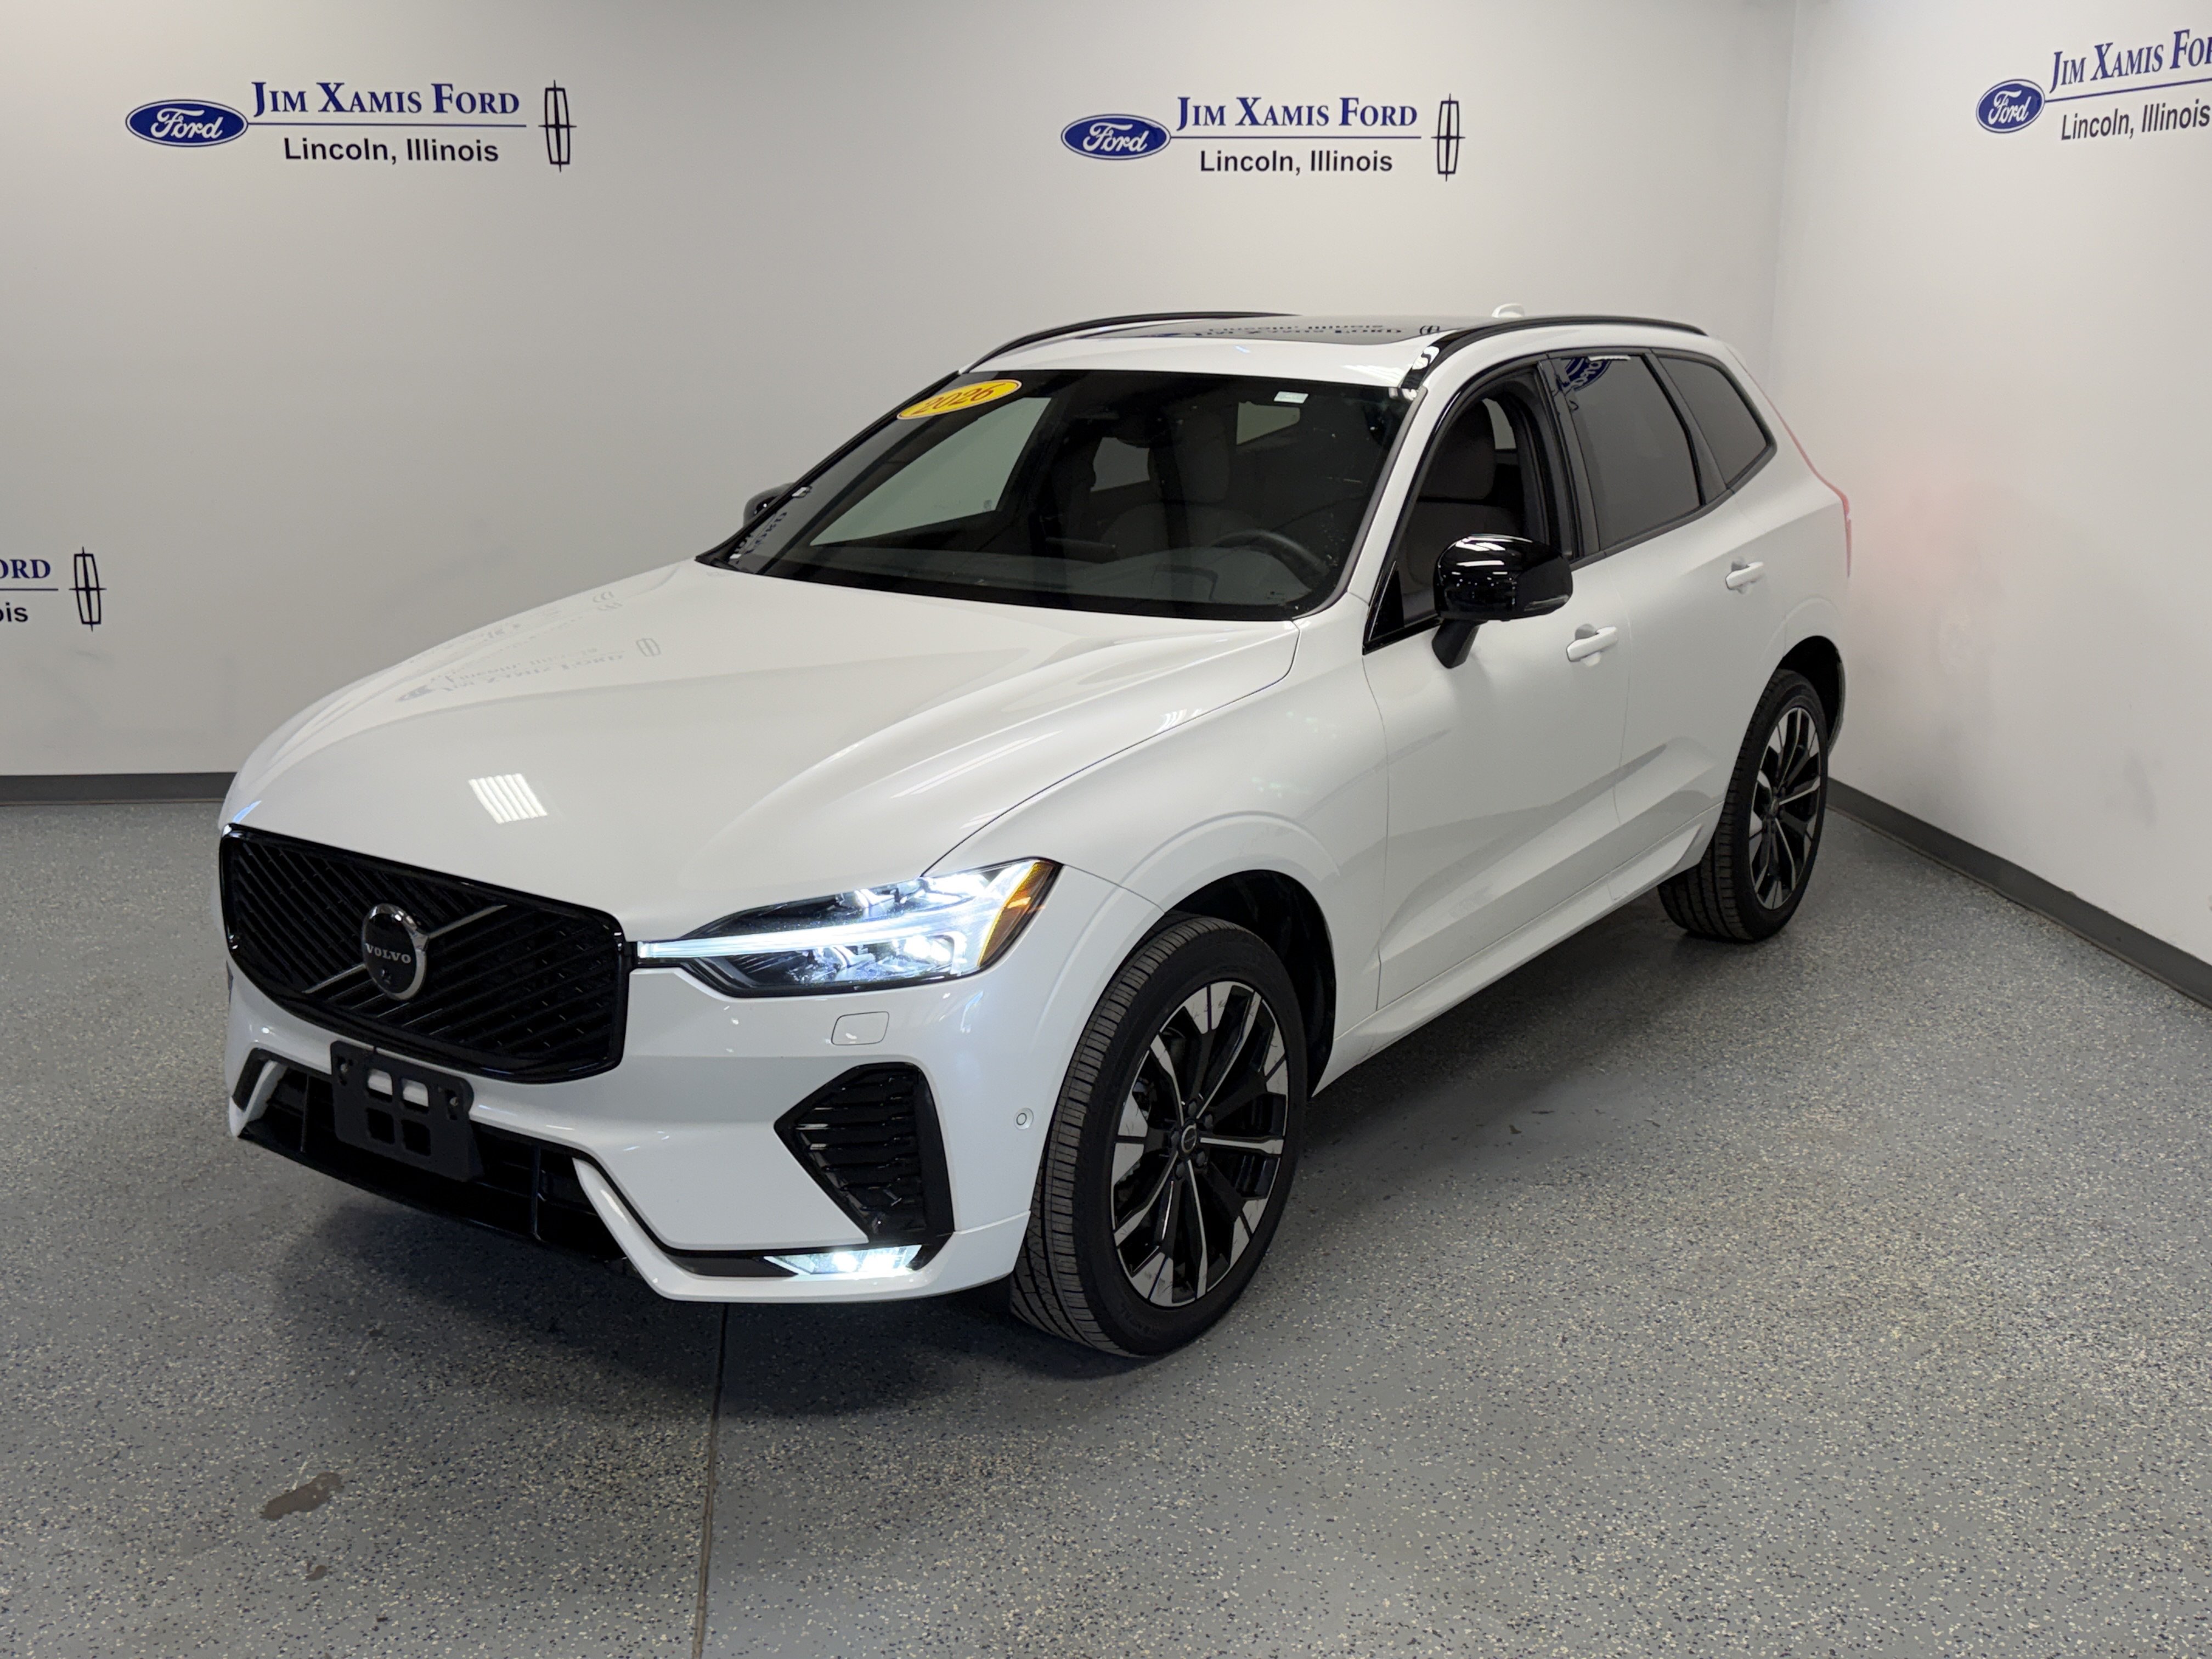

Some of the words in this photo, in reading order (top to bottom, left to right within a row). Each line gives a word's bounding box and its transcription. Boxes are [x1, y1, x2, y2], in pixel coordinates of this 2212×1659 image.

[1988, 89, 2032, 125] Ford
[2061, 108, 2134, 140] Lincoln,
[2141, 98, 2211, 133] Illinois
[150, 108, 224, 139] Ford
[1082, 122, 1150, 152] Ford
[284, 137, 396, 165] Lincoln,
[407, 138, 499, 162] Illinois
[1200, 150, 1300, 176] Lincoln,
[1311, 150, 1392, 172] Illinois
[911, 382, 1006, 415] 2026
[0, 602, 29, 623] is
[365, 943, 411, 964] VOLVO
